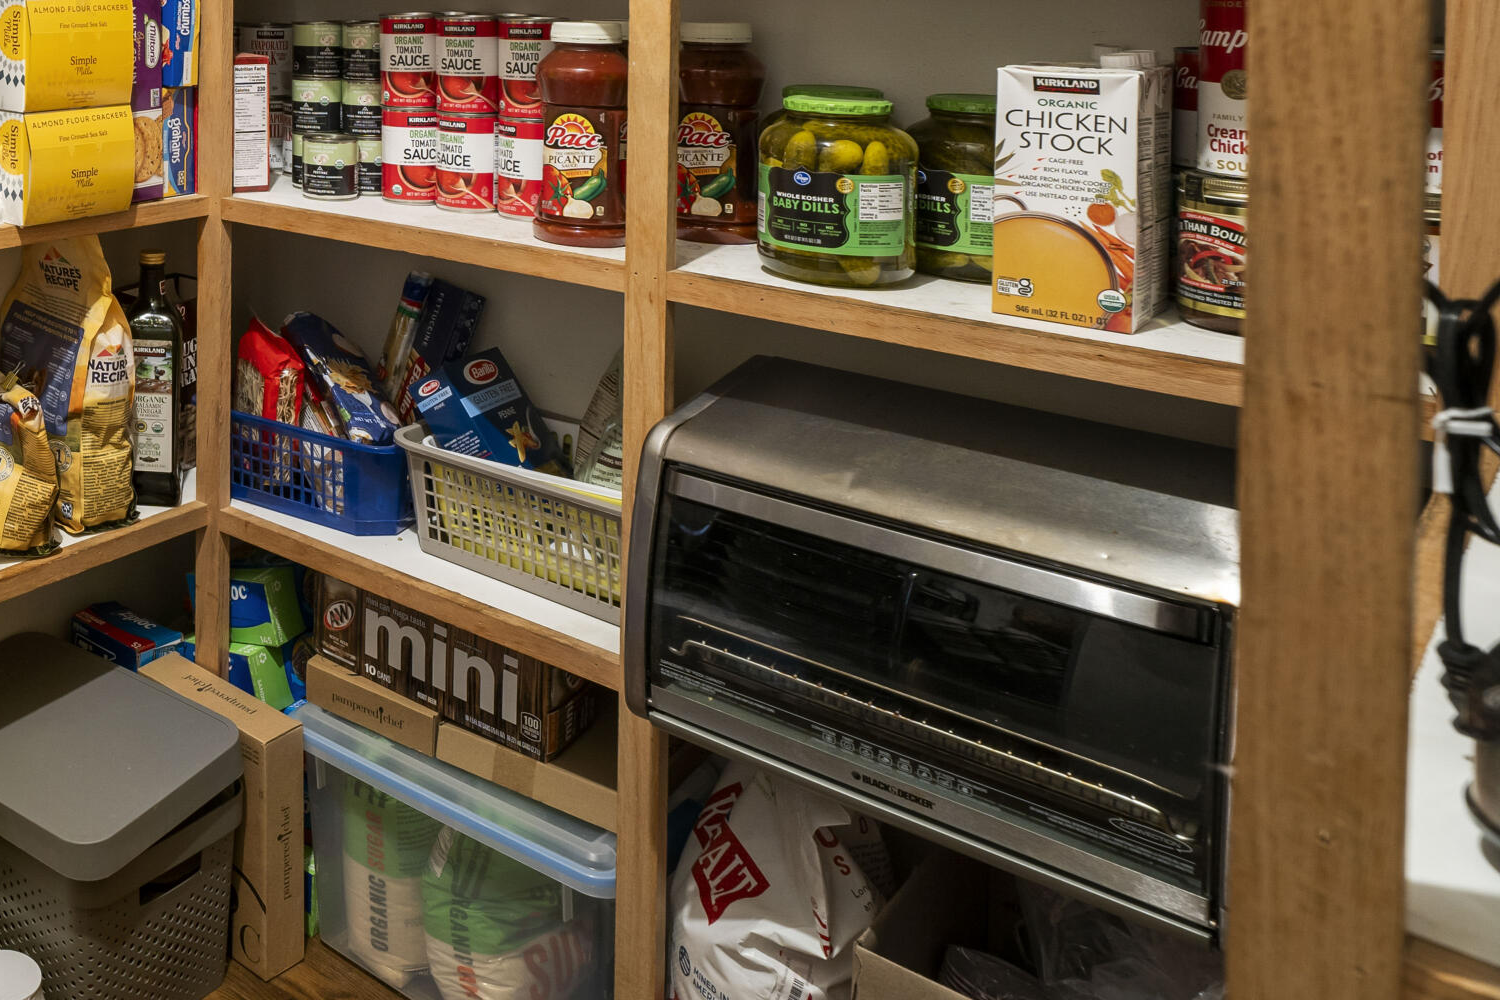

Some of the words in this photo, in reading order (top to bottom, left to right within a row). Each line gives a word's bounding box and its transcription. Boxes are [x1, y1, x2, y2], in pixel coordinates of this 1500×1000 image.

[33, 6, 65, 14] ALMOND
[67, 5, 90, 13] FLOUR
[93, 3, 128, 12] CRACKERS
[394, 36, 424, 45] ORGANIC
[396, 46, 422, 54] TOMATO
[70, 55, 97, 67] Simple
[390, 55, 430, 66] SAUCE
[1036, 78, 1098, 89] KIRKLAND
[1037, 98, 1098, 110] ORGANIC
[1006, 109, 1127, 134] CHICKEN
[1212, 113, 1243, 121] FAMILY
[167, 118, 180, 163] grahams
[544, 125, 603, 149] Pace
[1020, 131, 1113, 156] STOCK
[548, 155, 595, 165] PICANTE
[1048, 157, 1084, 165] CAGE-FREE
[1061, 168, 1088, 176] FLAVOR
[1021, 181, 1053, 189] ORGANIC
[1055, 184, 1085, 192] CHICKEN
[776, 191, 800, 199] WHOLE
[801, 194, 834, 203] KOSHER
[1040, 192, 1068, 200] INSTEAD
[773, 196, 800, 210] BABY
[802, 201, 840, 214] DILLS
[1184, 220, 1207, 234] THAN
[44, 274, 79, 292] RECIPE
[1016, 304, 1030, 313] 946
[471, 362, 495, 379] Barilla
[474, 391, 499, 406] GLUTEN
[499, 381, 516, 396] FREE
[365, 607, 518, 726] mini
[364, 663, 376, 676] 10
[377, 670, 391, 685] CANS
[523, 716, 539, 730] 100
[862, 774, 934, 810] BLACK&DECKER
[366, 810, 385, 872] SUGAR
[368, 874, 389, 952] ORGANIC
[693, 967, 718, 994] MINED
